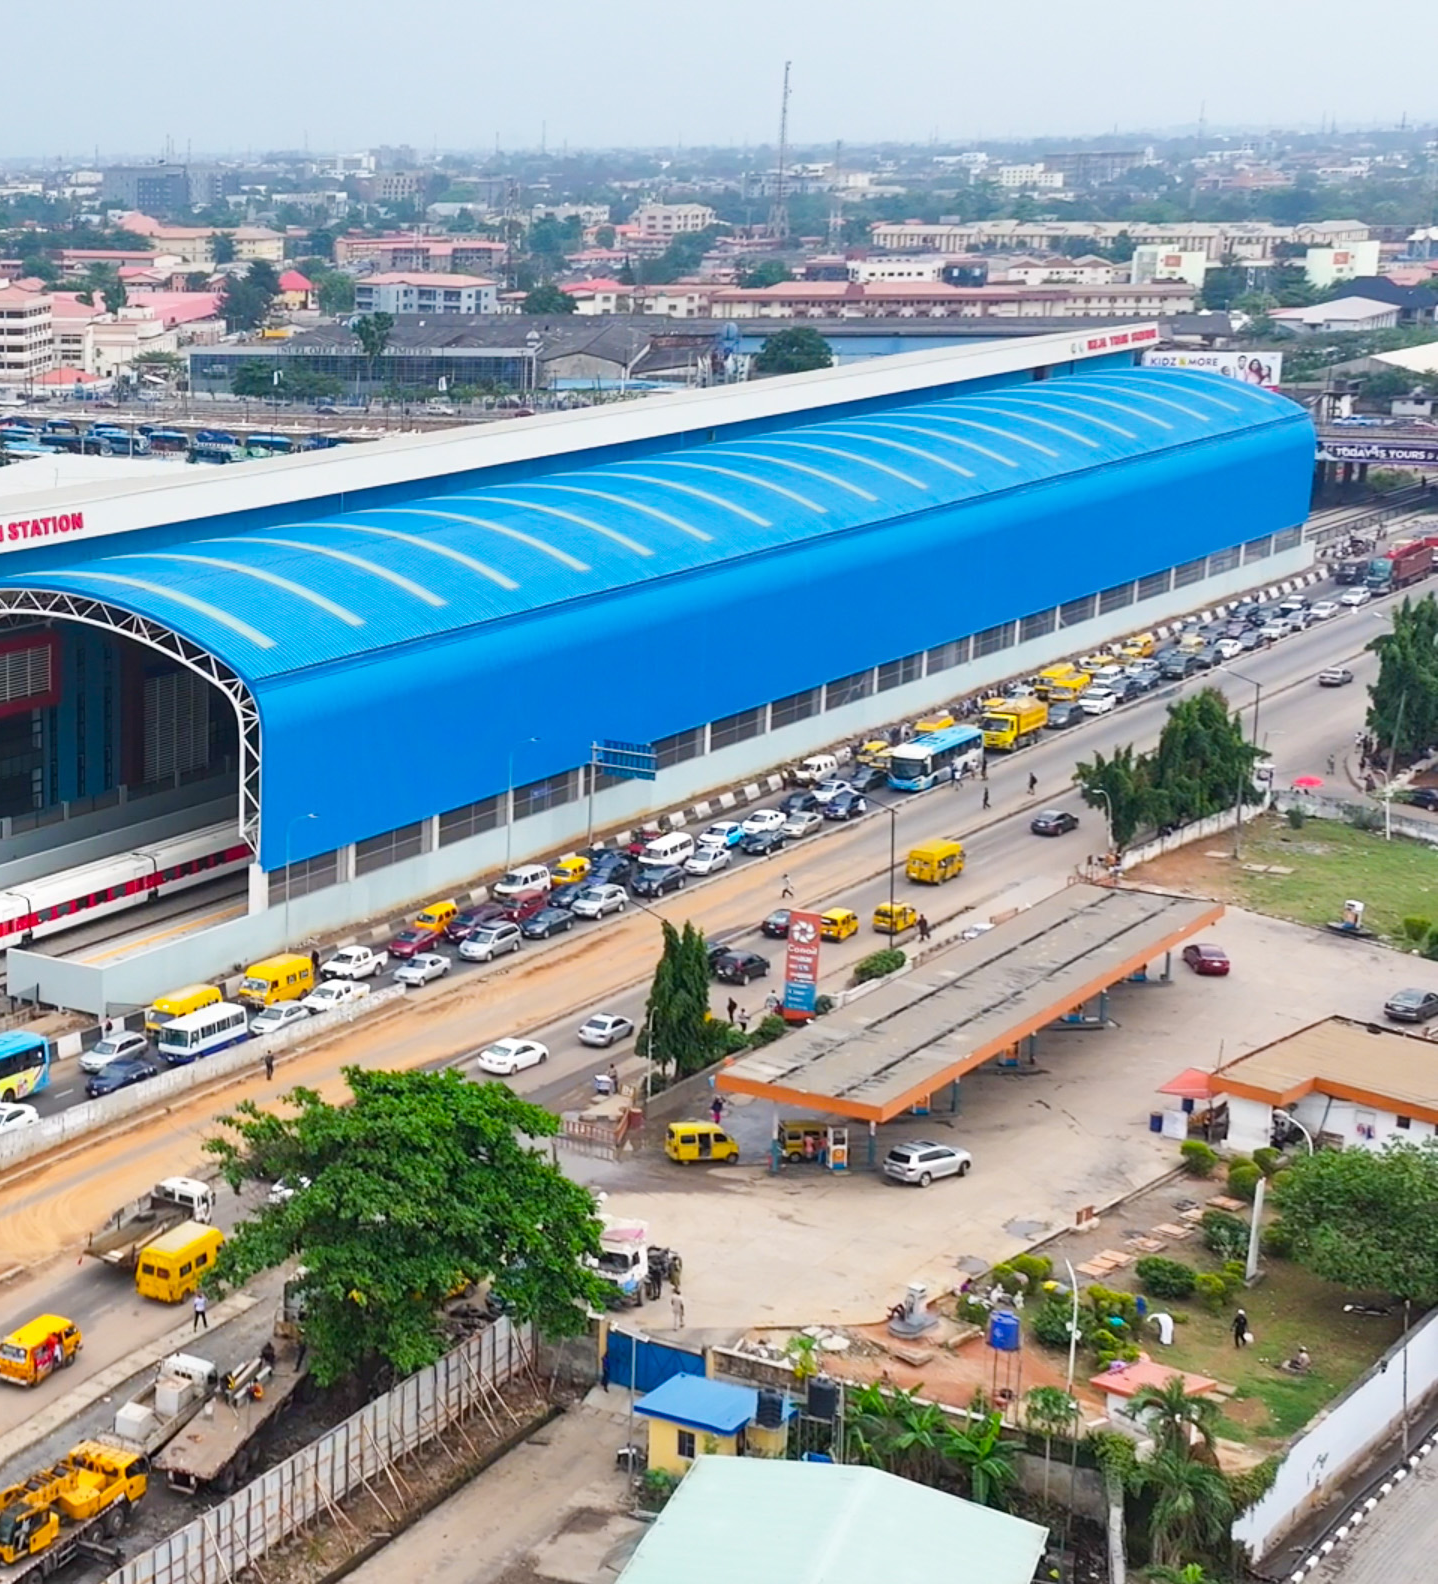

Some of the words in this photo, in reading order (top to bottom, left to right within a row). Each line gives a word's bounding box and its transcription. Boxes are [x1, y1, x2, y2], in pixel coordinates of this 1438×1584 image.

[1150, 356, 1177, 367] KIDZ
[1187, 357, 1219, 367] MORE
[1335, 446, 1372, 458] TODAY
[1388, 449, 1426, 460] YOURS
[7, 511, 84, 541] STATION
[787, 944, 818, 955] Conoil
